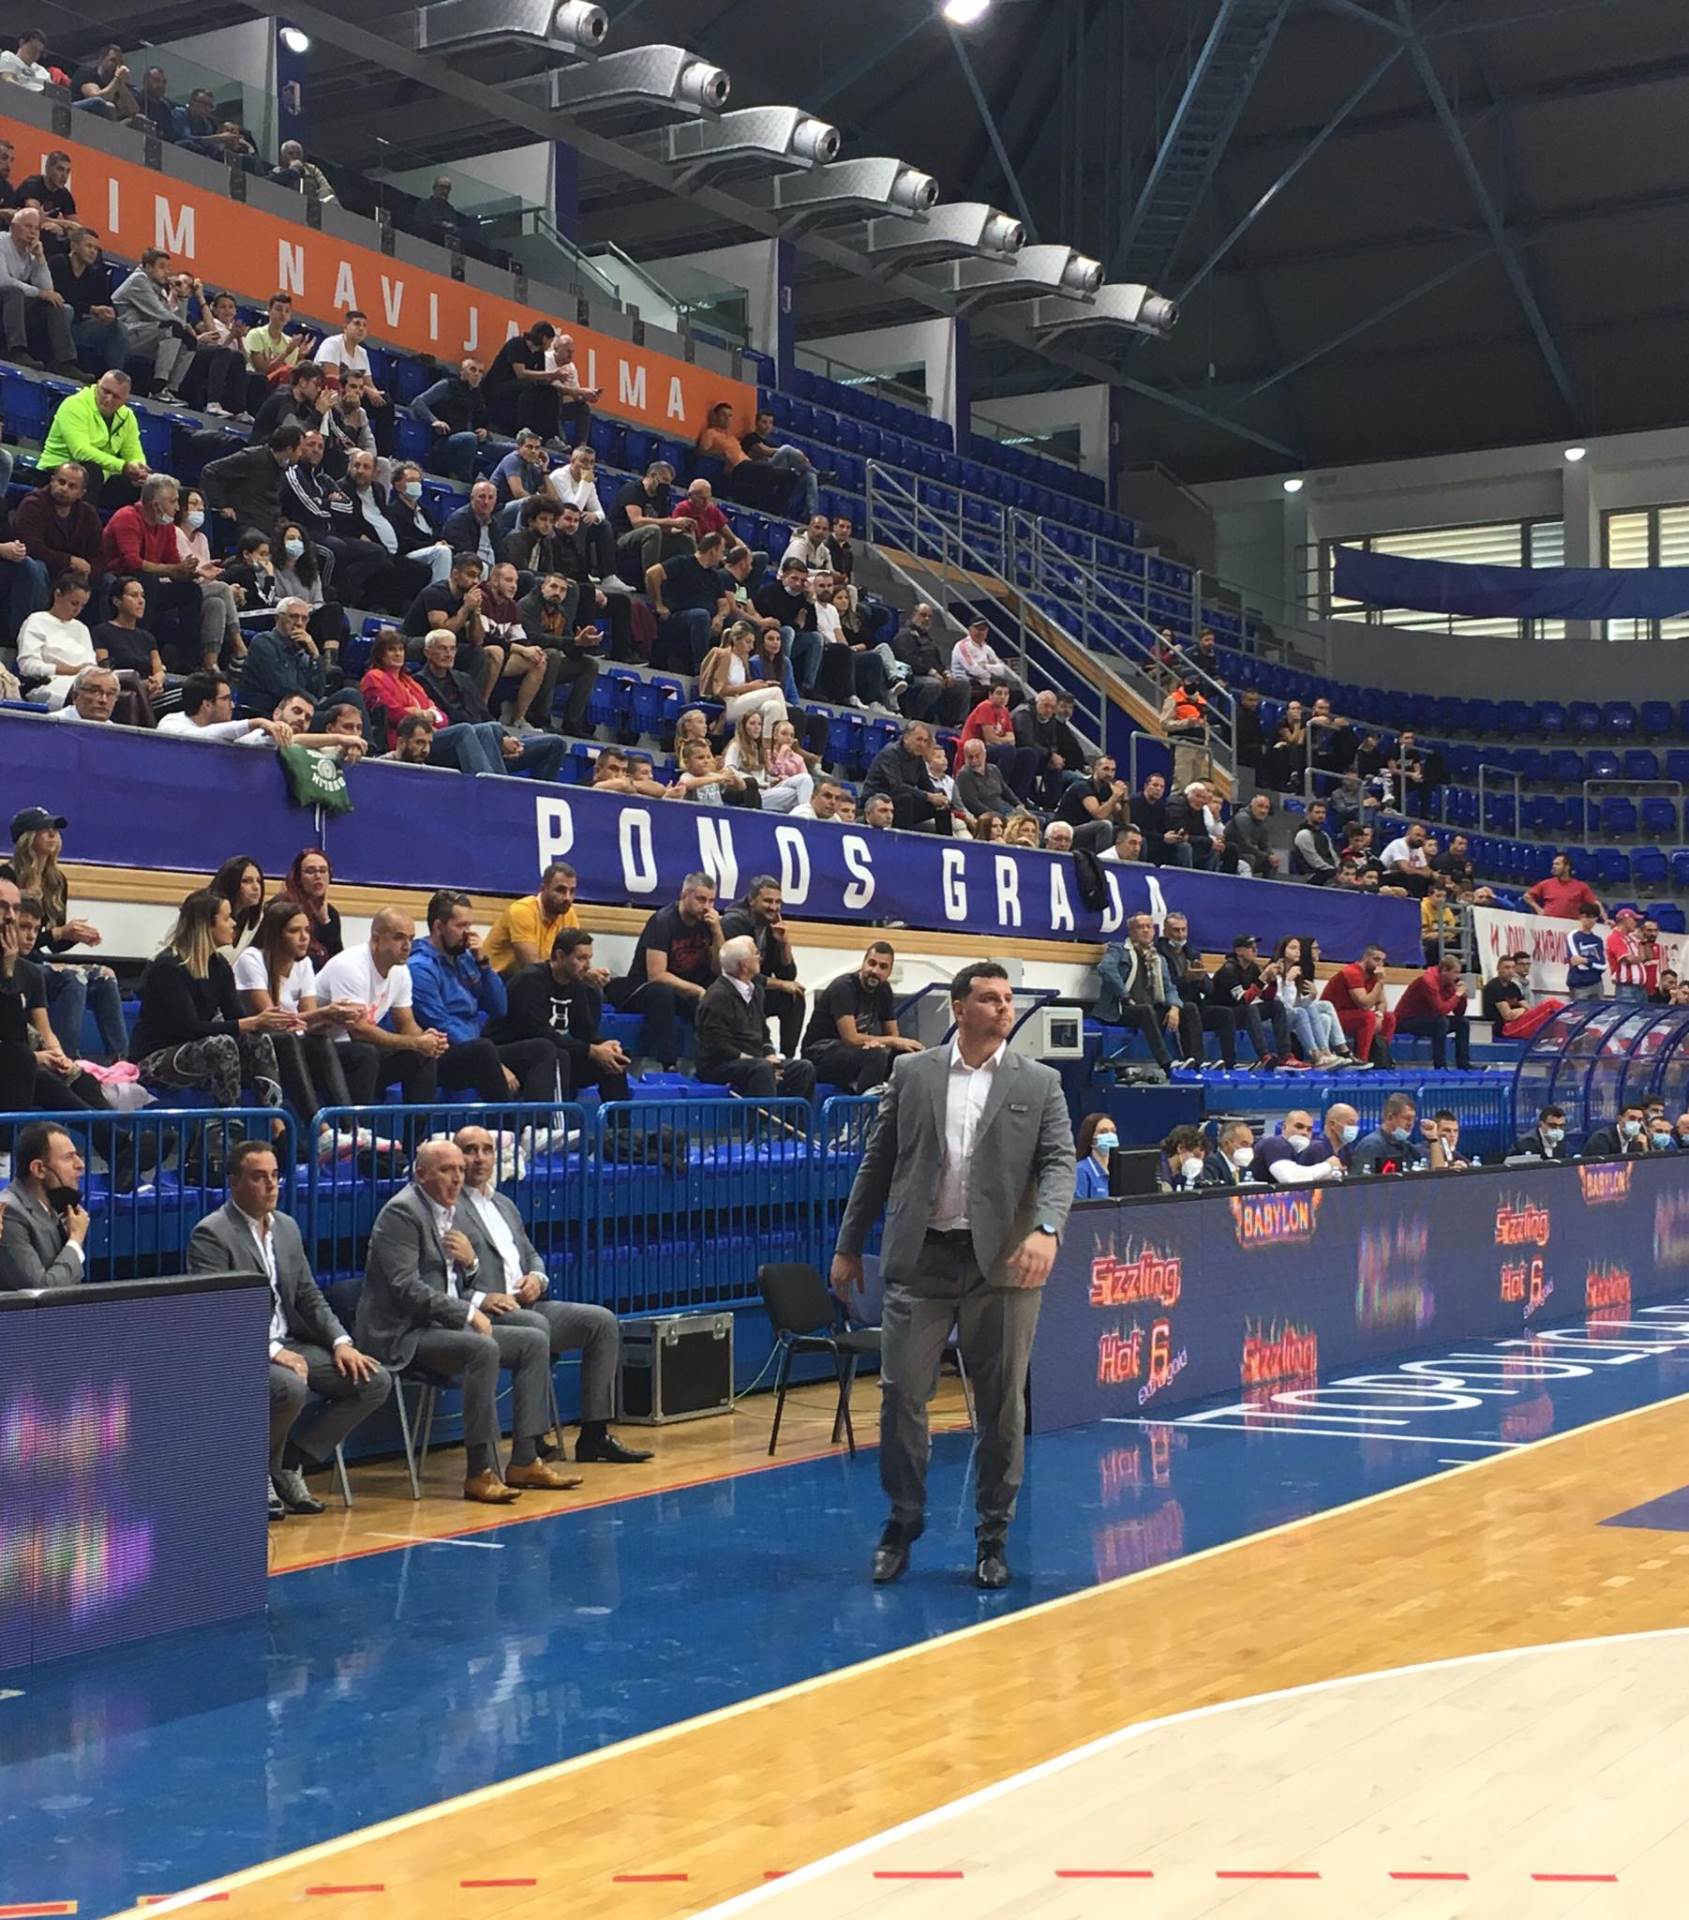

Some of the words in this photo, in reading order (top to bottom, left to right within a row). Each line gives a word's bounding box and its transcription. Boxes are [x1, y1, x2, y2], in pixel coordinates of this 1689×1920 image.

[278, 239, 685, 422] NAVIJIMA
[536, 795, 875, 910] PONOS
[1243, 1200, 1309, 1238] BABYLON
[1089, 1252, 1181, 1307] Sizzling
[1099, 1330, 1141, 1383] Hot
[1150, 1318, 1169, 1382] 6
